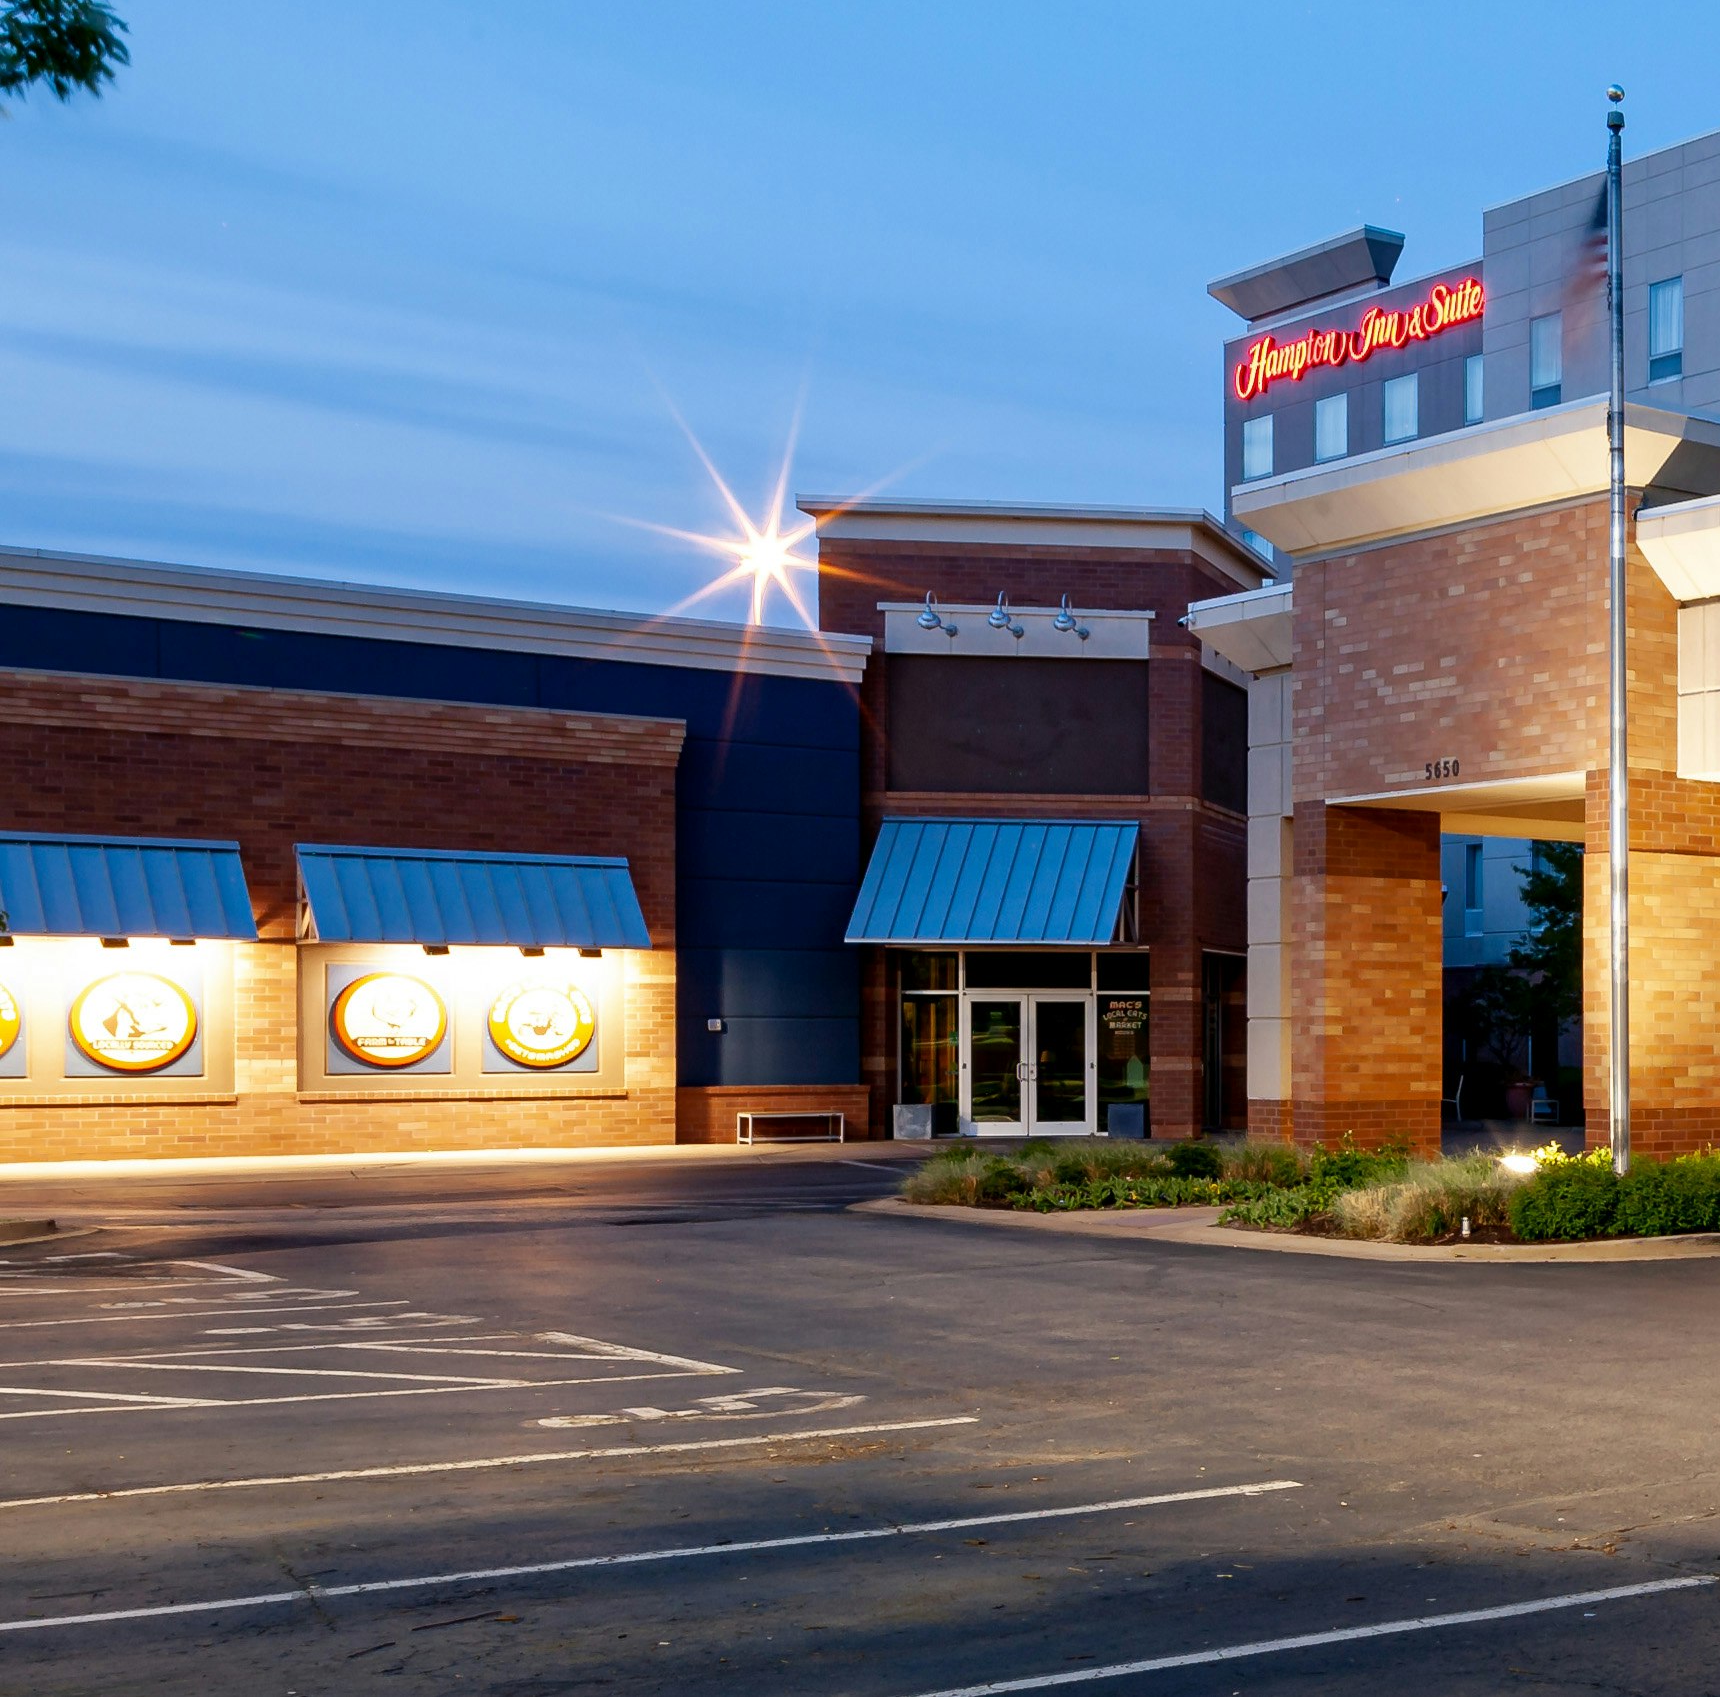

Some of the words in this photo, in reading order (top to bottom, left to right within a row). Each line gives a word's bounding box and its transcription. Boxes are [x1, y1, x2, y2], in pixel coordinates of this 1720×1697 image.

[1234, 331, 1347, 399] Hampton
[1348, 306, 1409, 360] Inn
[1408, 305, 1425, 339] &
[1423, 279, 1484, 332] Suite
[1424, 759, 1460, 780] 5650
[1110, 1001, 1142, 1009] MAC'S
[1103, 1010, 1125, 1020] LOCAL
[356, 1037, 388, 1047] FARM
[395, 1037, 426, 1047] TABLE
